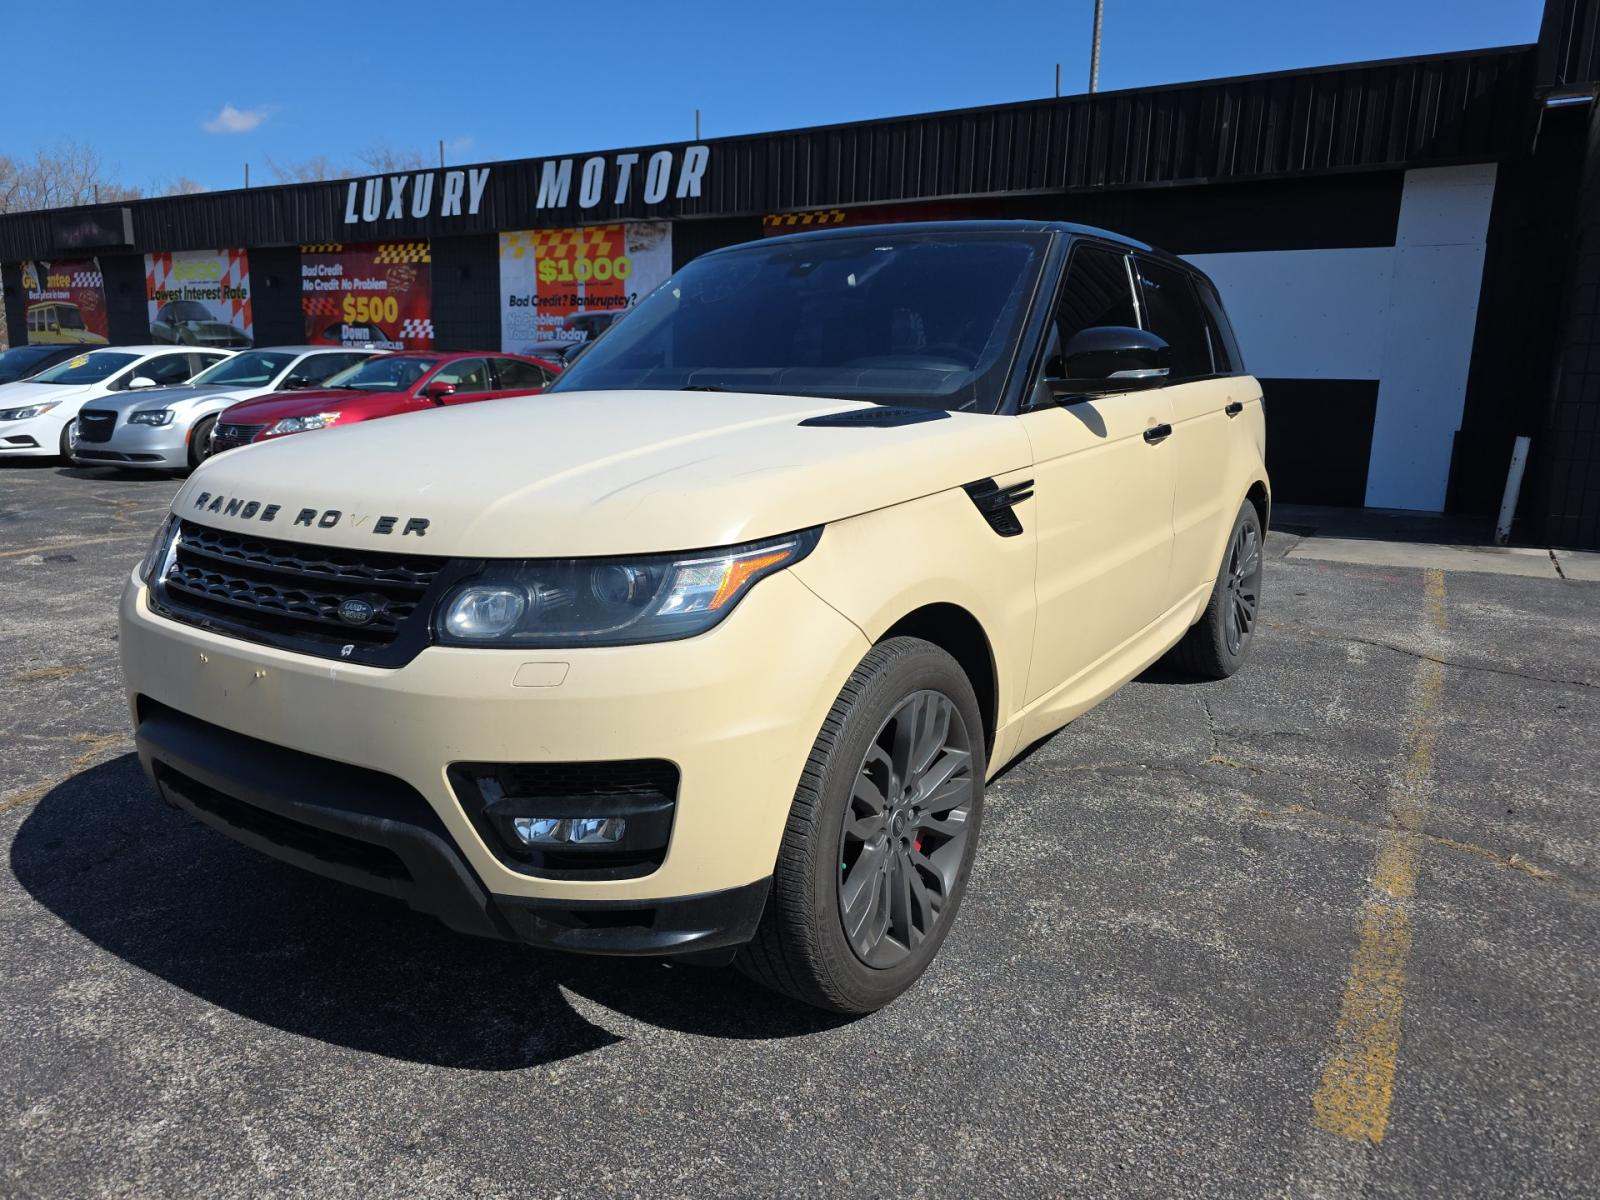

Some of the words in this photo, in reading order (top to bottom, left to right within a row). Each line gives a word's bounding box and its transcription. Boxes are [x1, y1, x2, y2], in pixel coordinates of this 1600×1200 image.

[345, 168, 490, 224] LUXURY
[536, 145, 710, 209] MOTOR
[302, 265, 317, 276] Bad
[318, 264, 342, 276] Credit
[538, 256, 632, 283] $1000
[303, 279, 314, 291] No
[315, 279, 338, 290] Credit
[342, 278, 352, 290] No
[354, 277, 387, 290] Problem
[150, 287, 182, 300] Lowest
[184, 285, 221, 300] Interest
[223, 285, 248, 299] Rate
[342, 293, 398, 324] $500
[509, 295, 529, 307] Bad
[531, 294, 568, 307] Credit?
[570, 292, 637, 310] Bankruptcy?
[342, 324, 370, 339] Down
[556, 327, 588, 341] Today
[194, 491, 282, 521] RANGE
